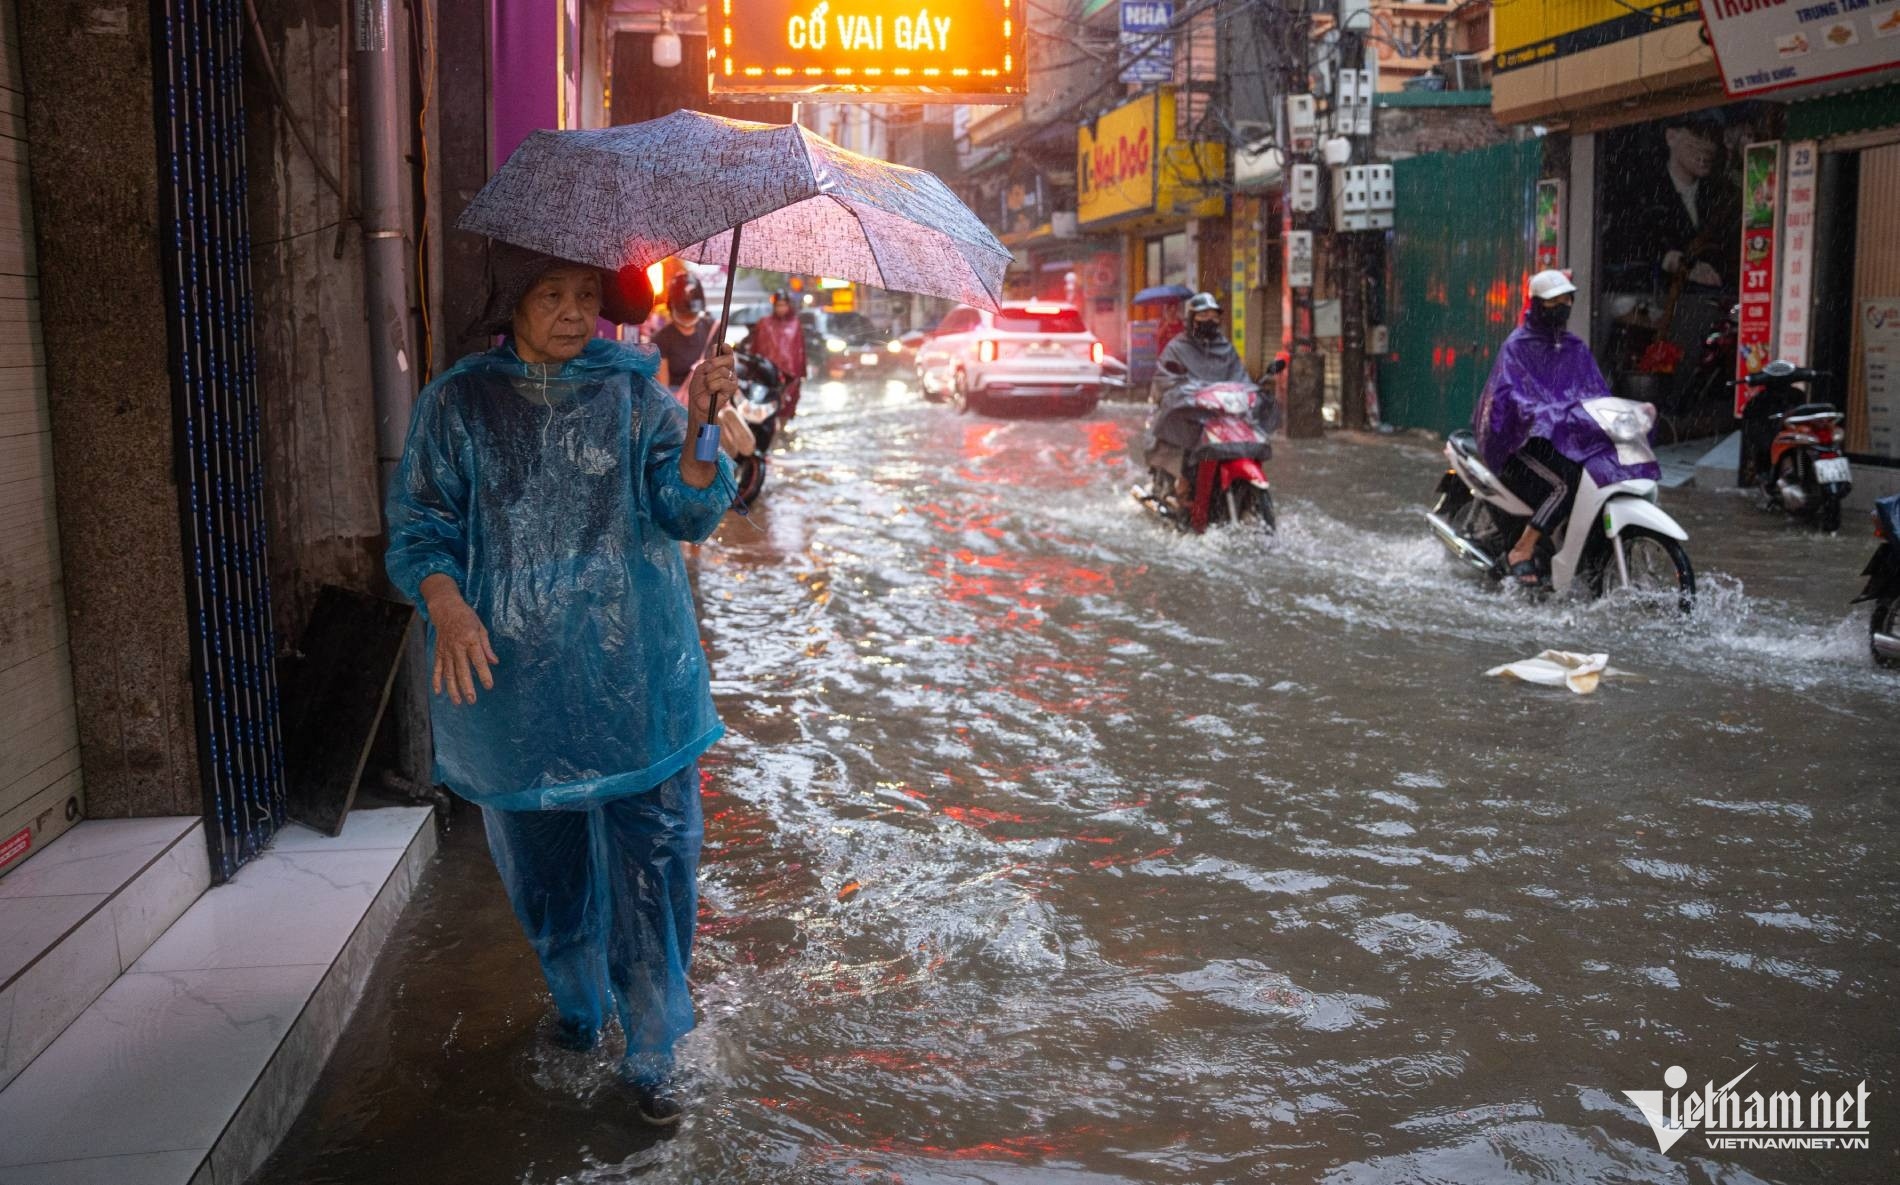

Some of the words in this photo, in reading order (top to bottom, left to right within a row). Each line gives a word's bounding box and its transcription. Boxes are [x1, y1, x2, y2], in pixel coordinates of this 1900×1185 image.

[1796, 2, 1838, 23] TRUNG
[837, 15, 882, 50] VAI
[895, 9, 951, 51] GÁY
[1795, 149, 1809, 165] 29
[1748, 270, 1767, 288] 3T
